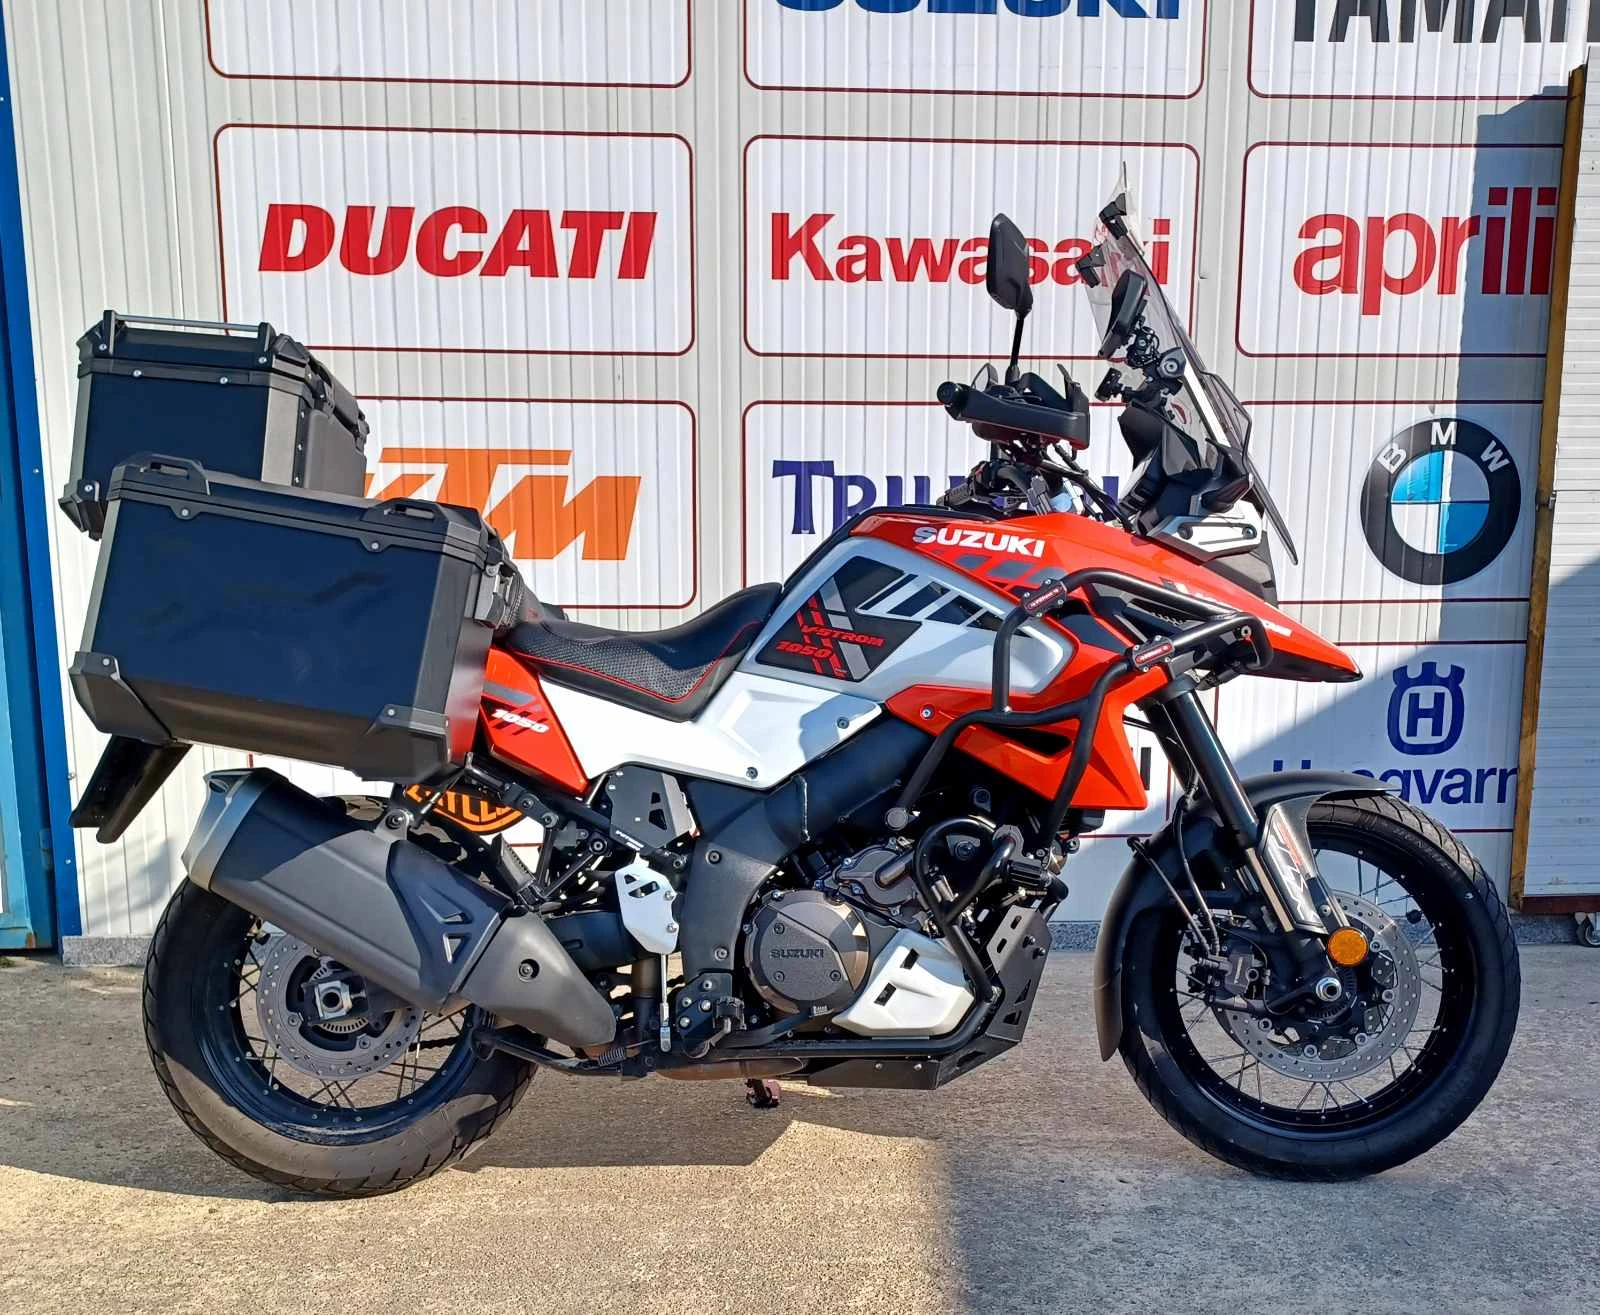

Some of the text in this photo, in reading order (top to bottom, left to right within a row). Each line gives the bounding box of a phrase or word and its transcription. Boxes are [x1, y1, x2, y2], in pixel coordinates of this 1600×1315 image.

[258, 203, 657, 279] DUCATI
[1377, 421, 1510, 475] BMW
[365, 447, 642, 561] TM
[912, 526, 1046, 558] SUZUKI
[776, 640, 834, 659] 1050
[491, 708, 550, 734] 1050
[1406, 692, 1445, 737] H
[770, 948, 824, 959] SUZUKI
